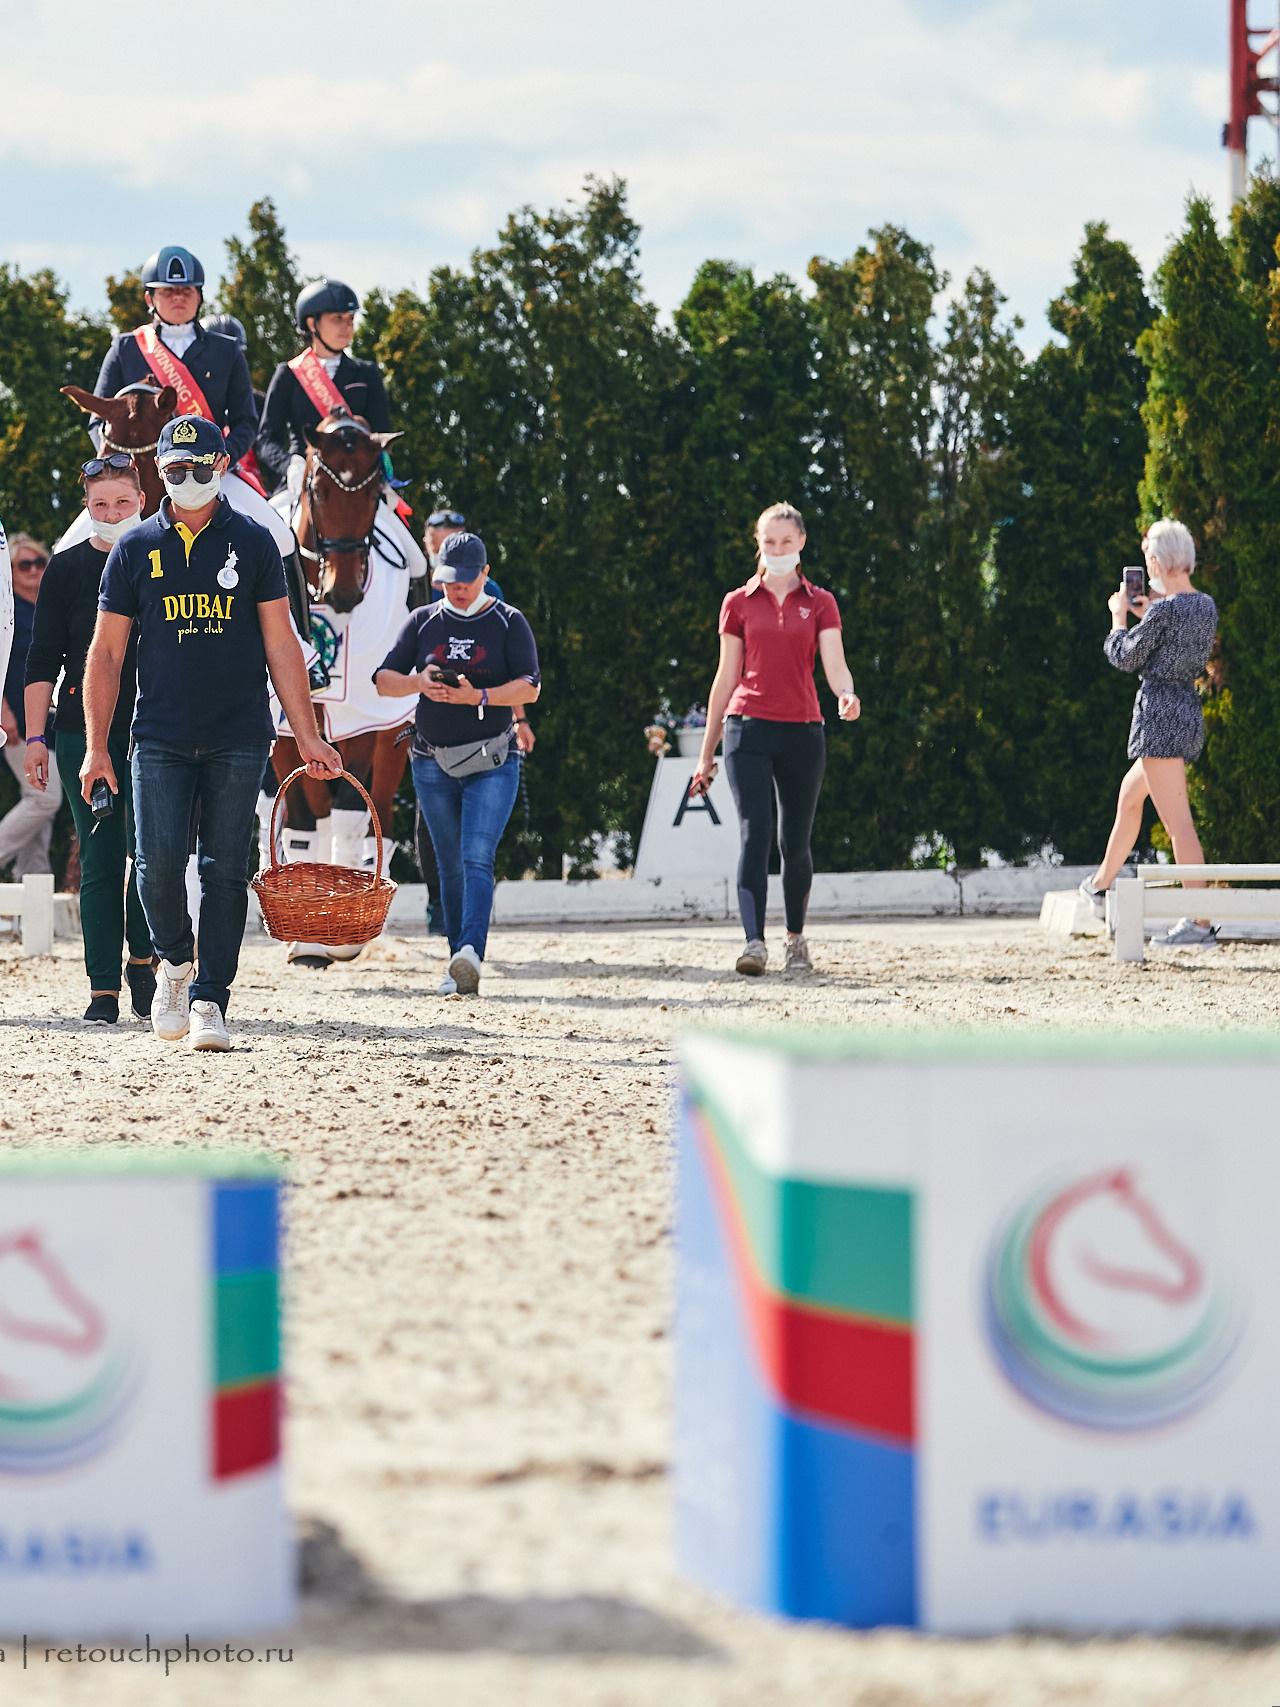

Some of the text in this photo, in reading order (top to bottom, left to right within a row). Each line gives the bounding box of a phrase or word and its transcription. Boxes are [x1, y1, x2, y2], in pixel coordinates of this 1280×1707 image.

[153, 342, 193, 403] WINNING
[148, 549, 164, 578] 1
[163, 594, 235, 621] DUBAI
[178, 620, 224, 643] polo club
[672, 776, 722, 826] A
[977, 1492, 1256, 1541] EURASIA
